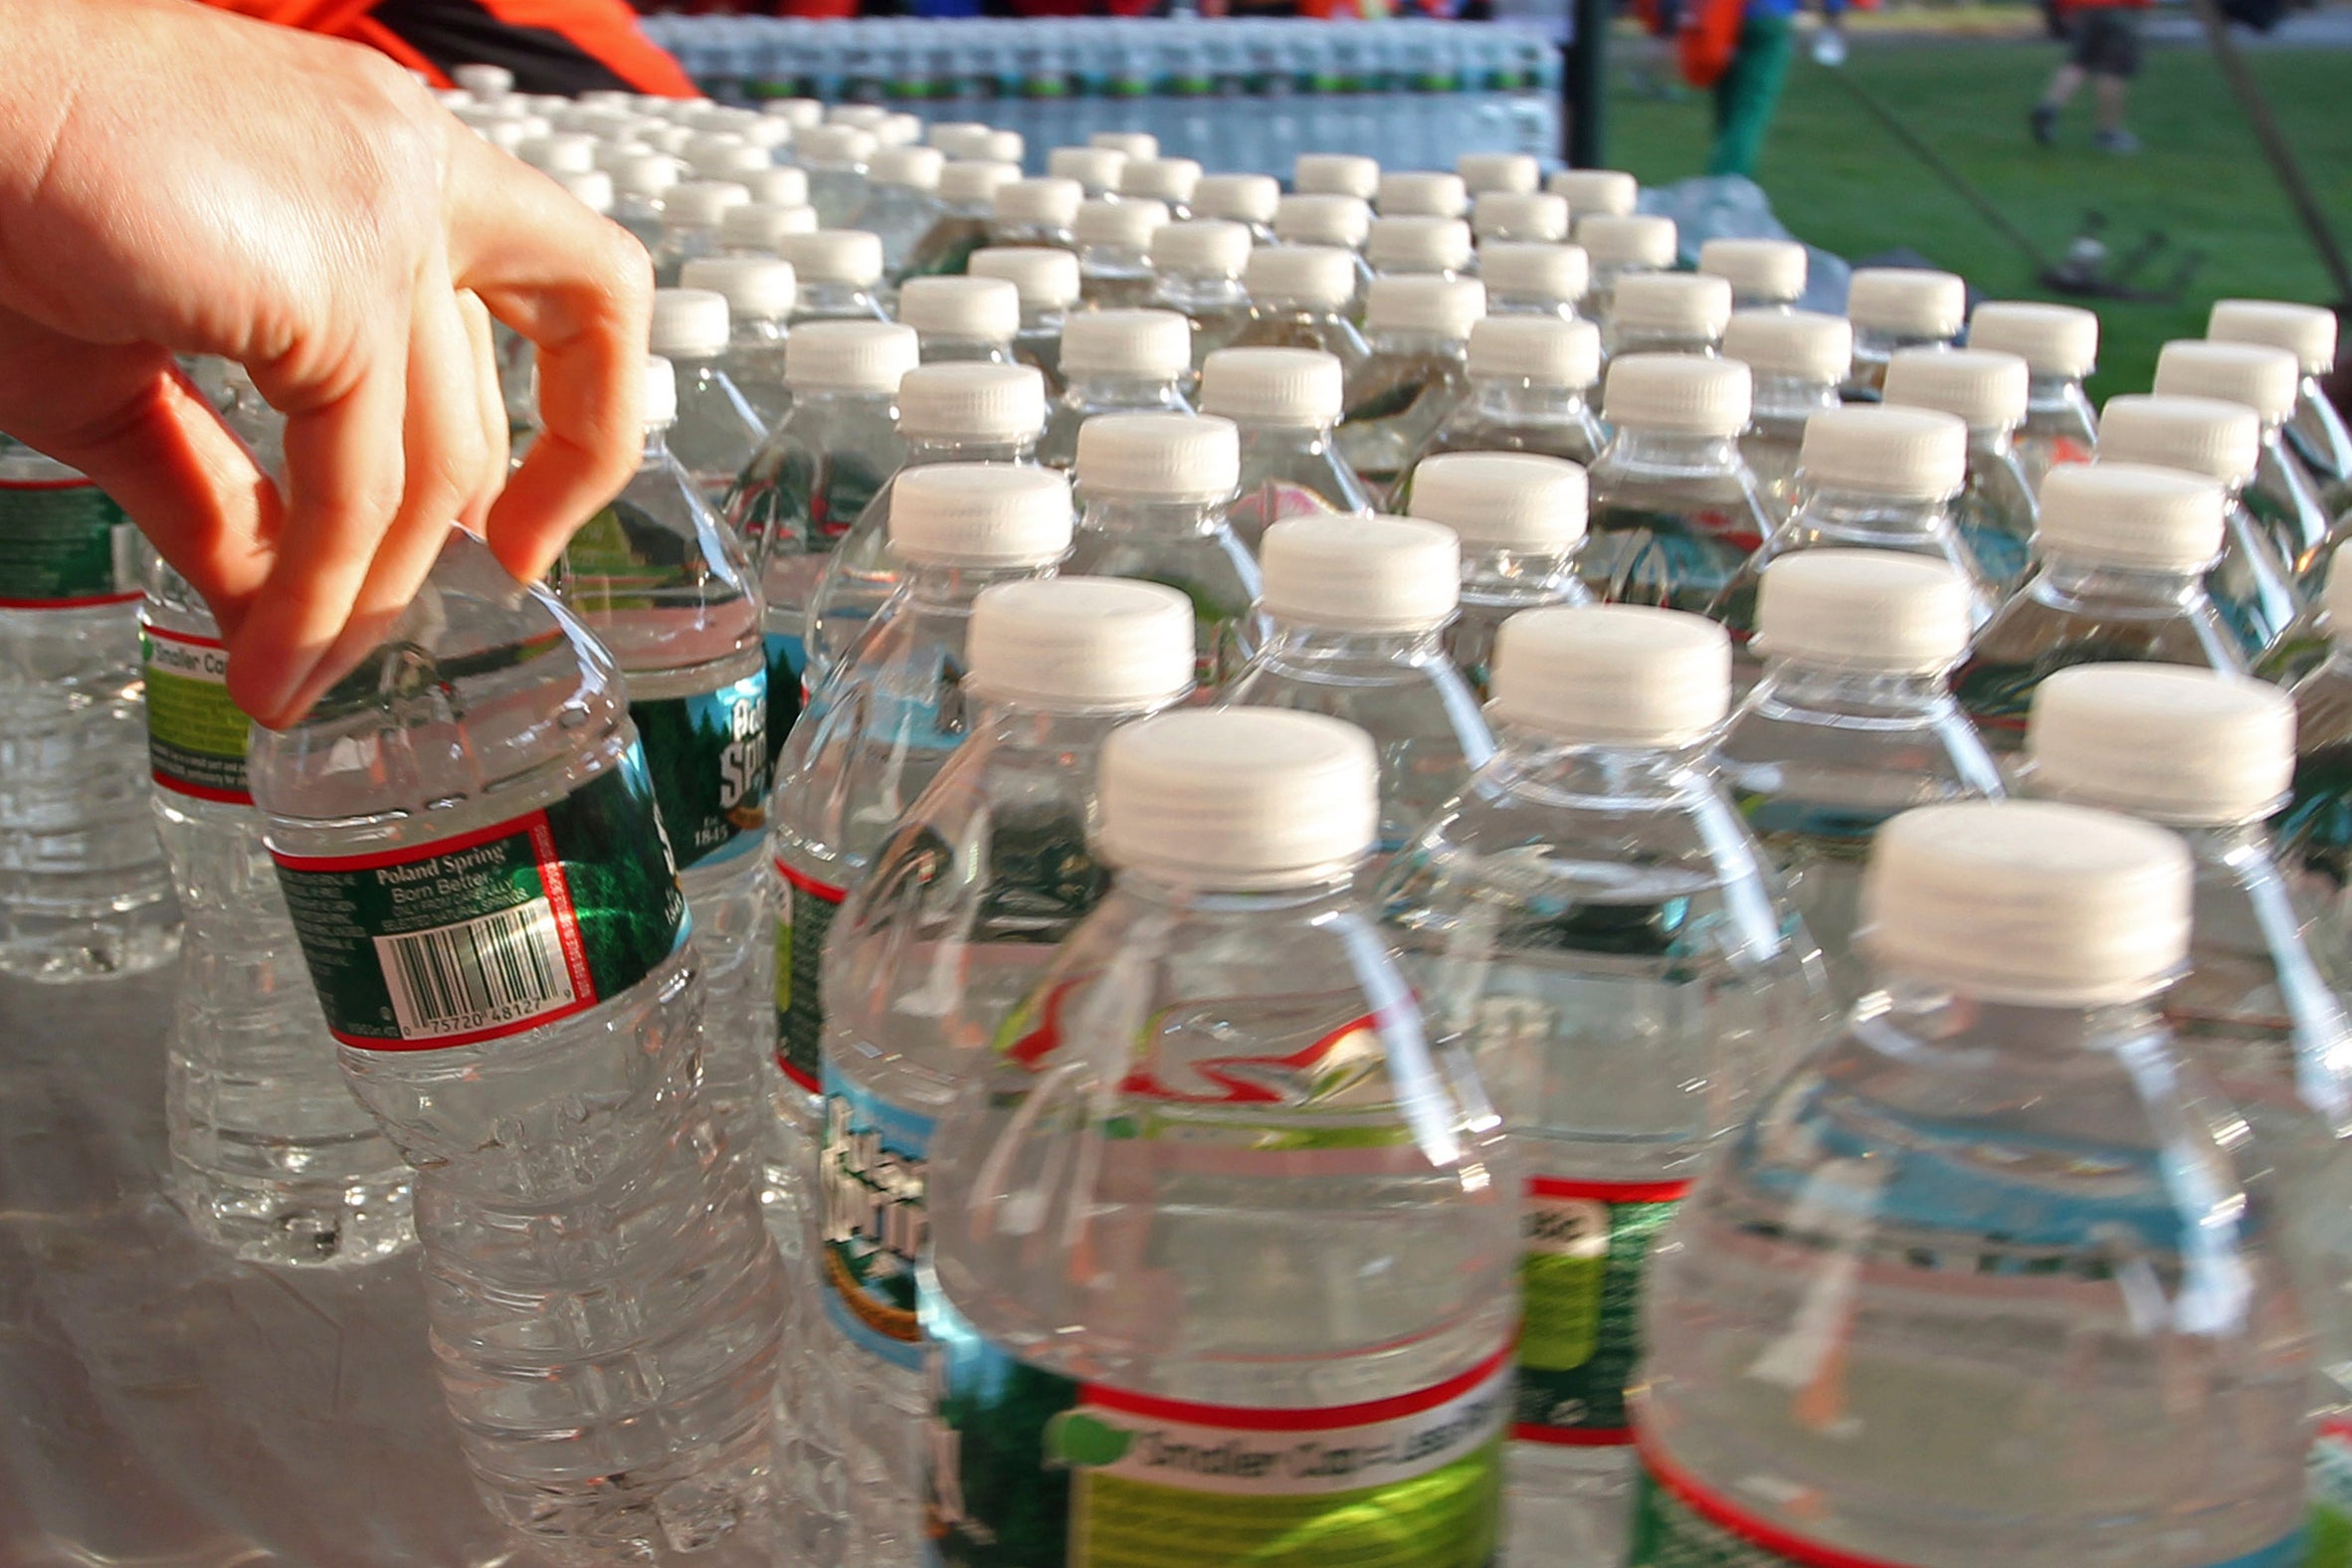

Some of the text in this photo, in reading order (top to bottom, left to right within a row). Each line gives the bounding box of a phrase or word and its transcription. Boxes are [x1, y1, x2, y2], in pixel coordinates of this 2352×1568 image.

[694, 829, 728, 847] 1845
[375, 847, 507, 885] Poland Spring
[391, 883, 434, 903] Born
[403, 1026, 411, 1037] 0
[429, 1013, 484, 1034] 75720
[490, 997, 541, 1022] 48127
[563, 989, 571, 1000] 9
